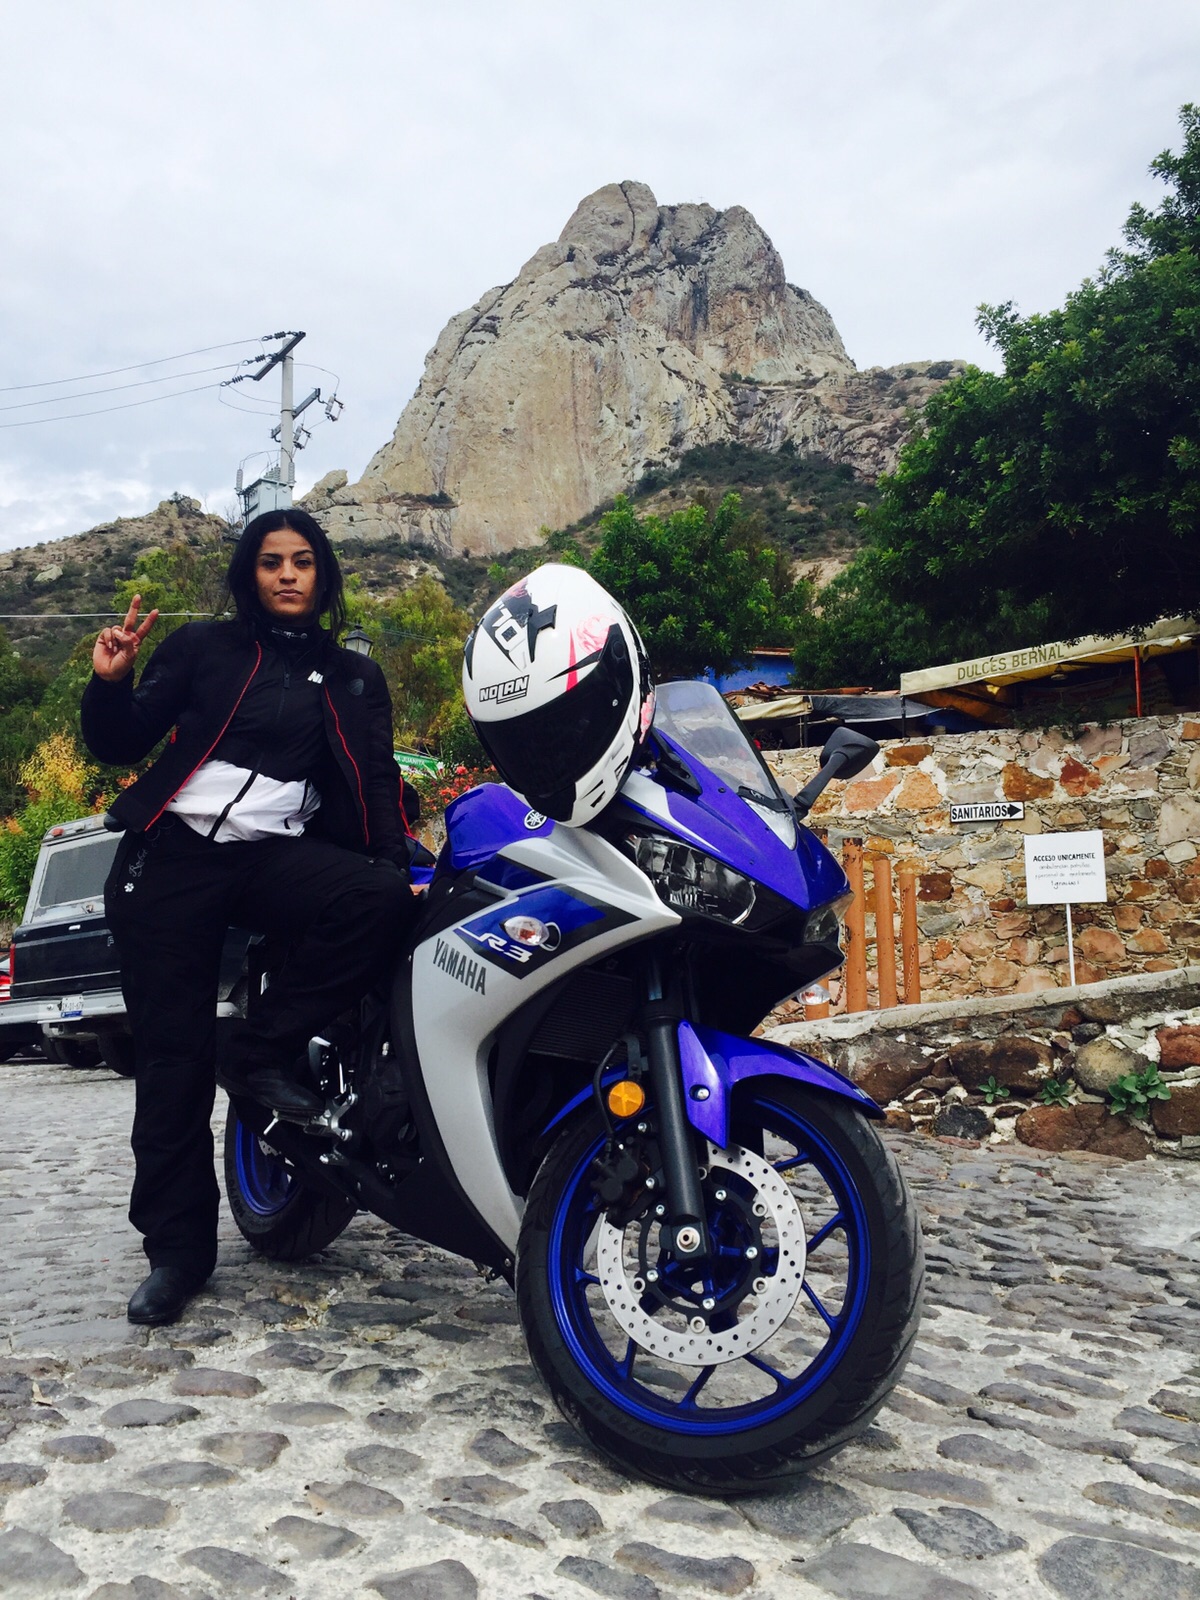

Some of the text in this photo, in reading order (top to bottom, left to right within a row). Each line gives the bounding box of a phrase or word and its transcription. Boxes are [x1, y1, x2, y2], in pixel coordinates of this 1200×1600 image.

[1012, 645, 1065, 668] BERNAL
[479, 675, 530, 704] NOLAN
[952, 805, 1008, 820] SANITARIOS
[1057, 852, 1096, 861] UNICAMENTE
[433, 938, 487, 996] YAMAHA
